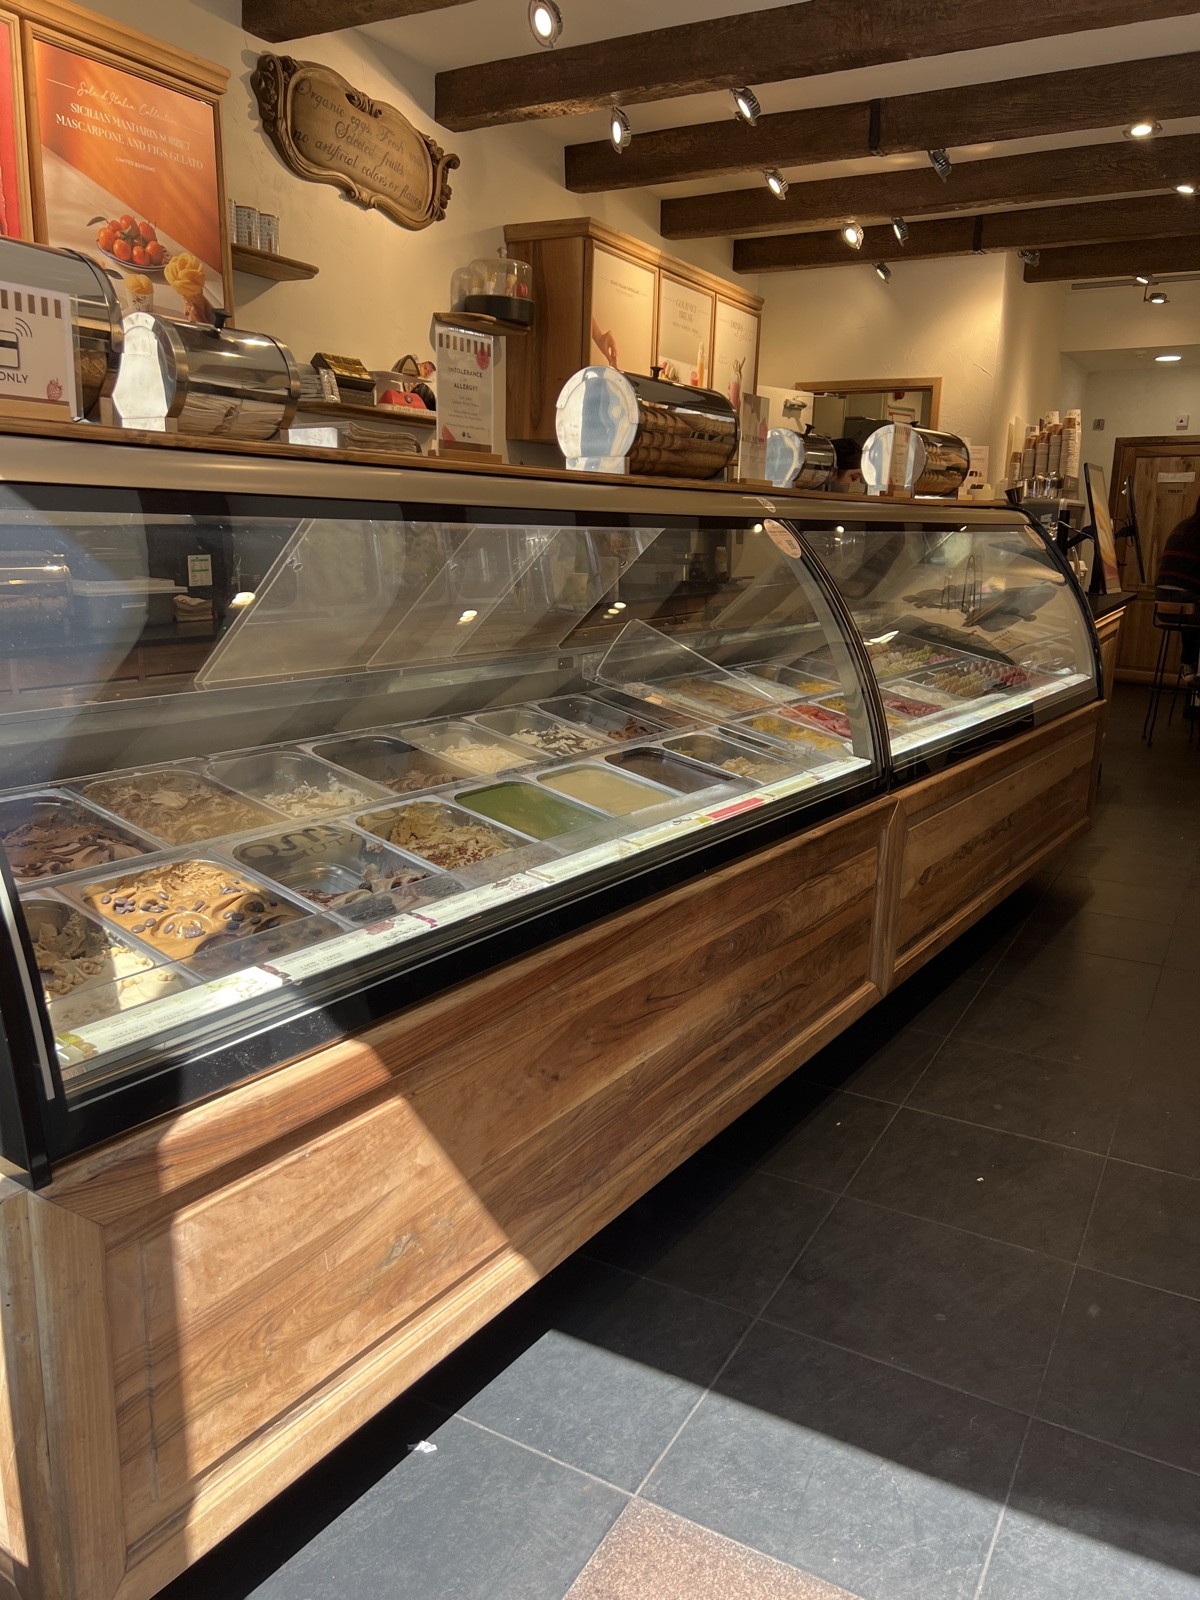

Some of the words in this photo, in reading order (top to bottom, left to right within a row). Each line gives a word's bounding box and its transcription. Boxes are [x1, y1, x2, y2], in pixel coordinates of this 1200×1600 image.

[56, 113, 125, 145] MASCARPONE
[127, 136, 145, 151] AND
[71, 103, 111, 124] SICILIAN
[111, 115, 158, 140] MANDARIN
